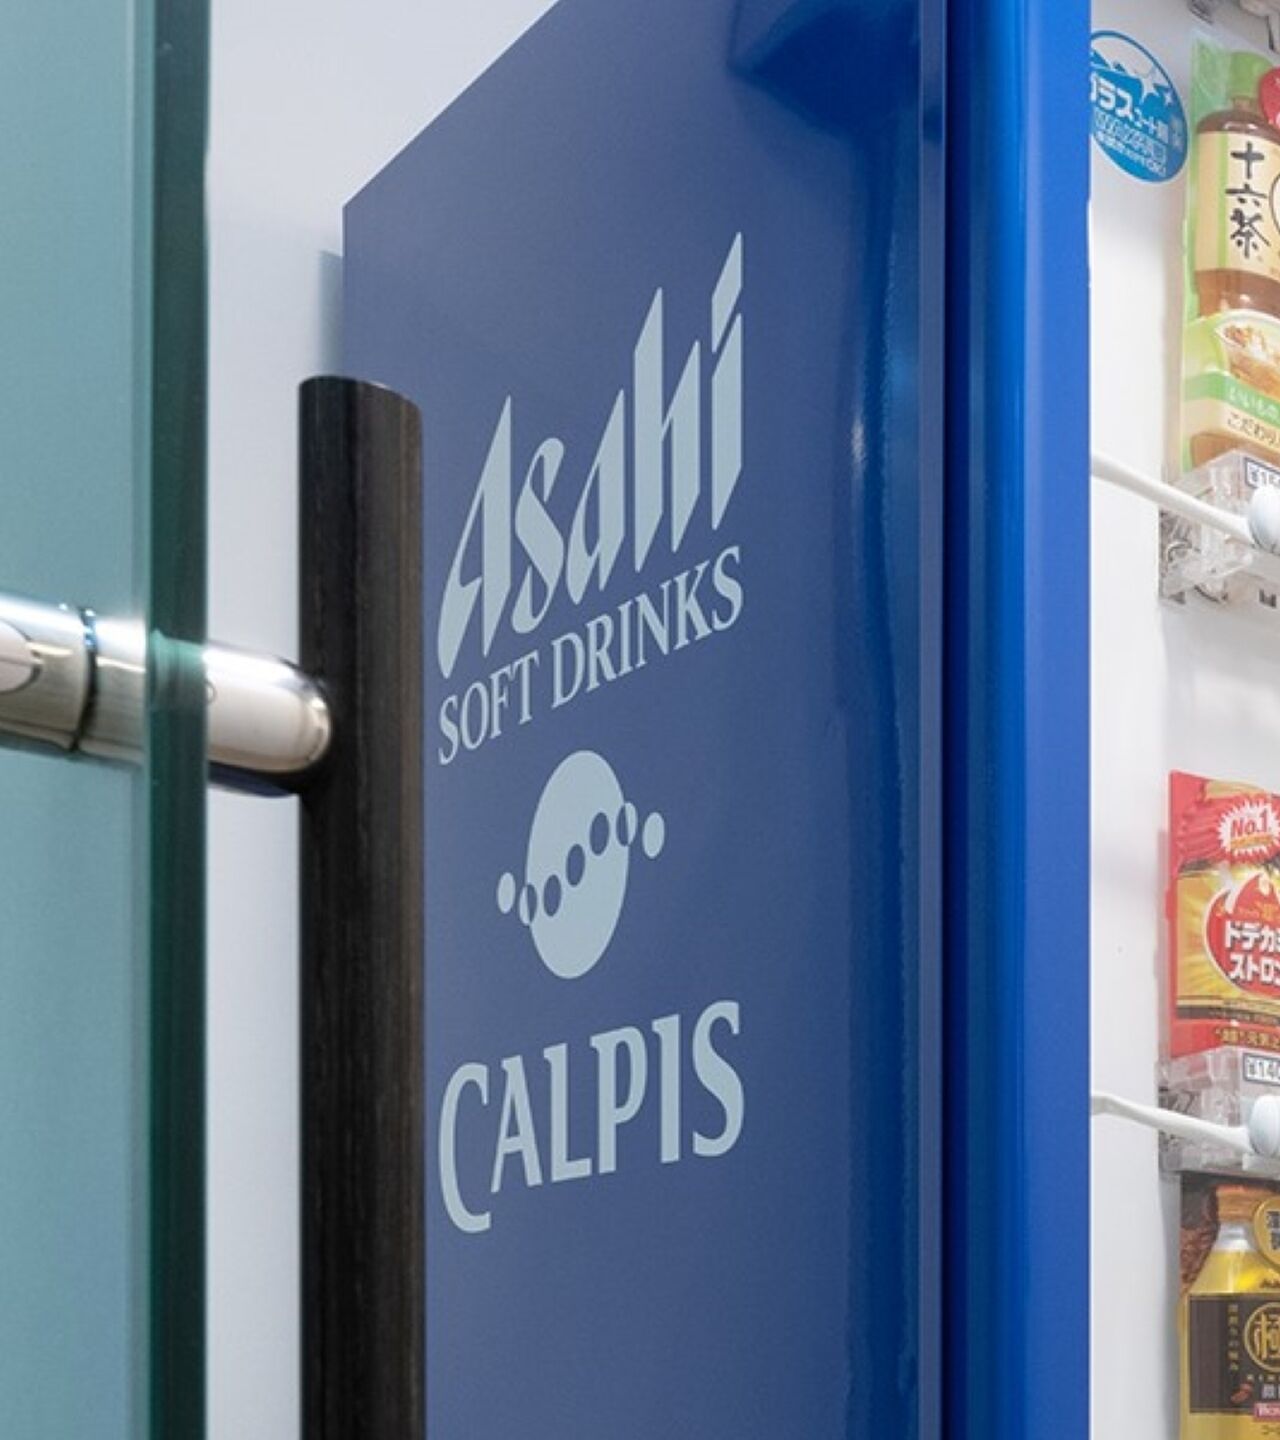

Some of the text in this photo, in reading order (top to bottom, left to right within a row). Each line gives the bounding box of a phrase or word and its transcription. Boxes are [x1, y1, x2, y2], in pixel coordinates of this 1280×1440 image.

[1225, 142, 1272, 259] 十六茶
[437, 231, 744, 679] Asahi
[438, 546, 744, 766] SOFT DRINKS
[1230, 807, 1271, 838] No.1
[438, 999, 746, 1234] CALPIS
